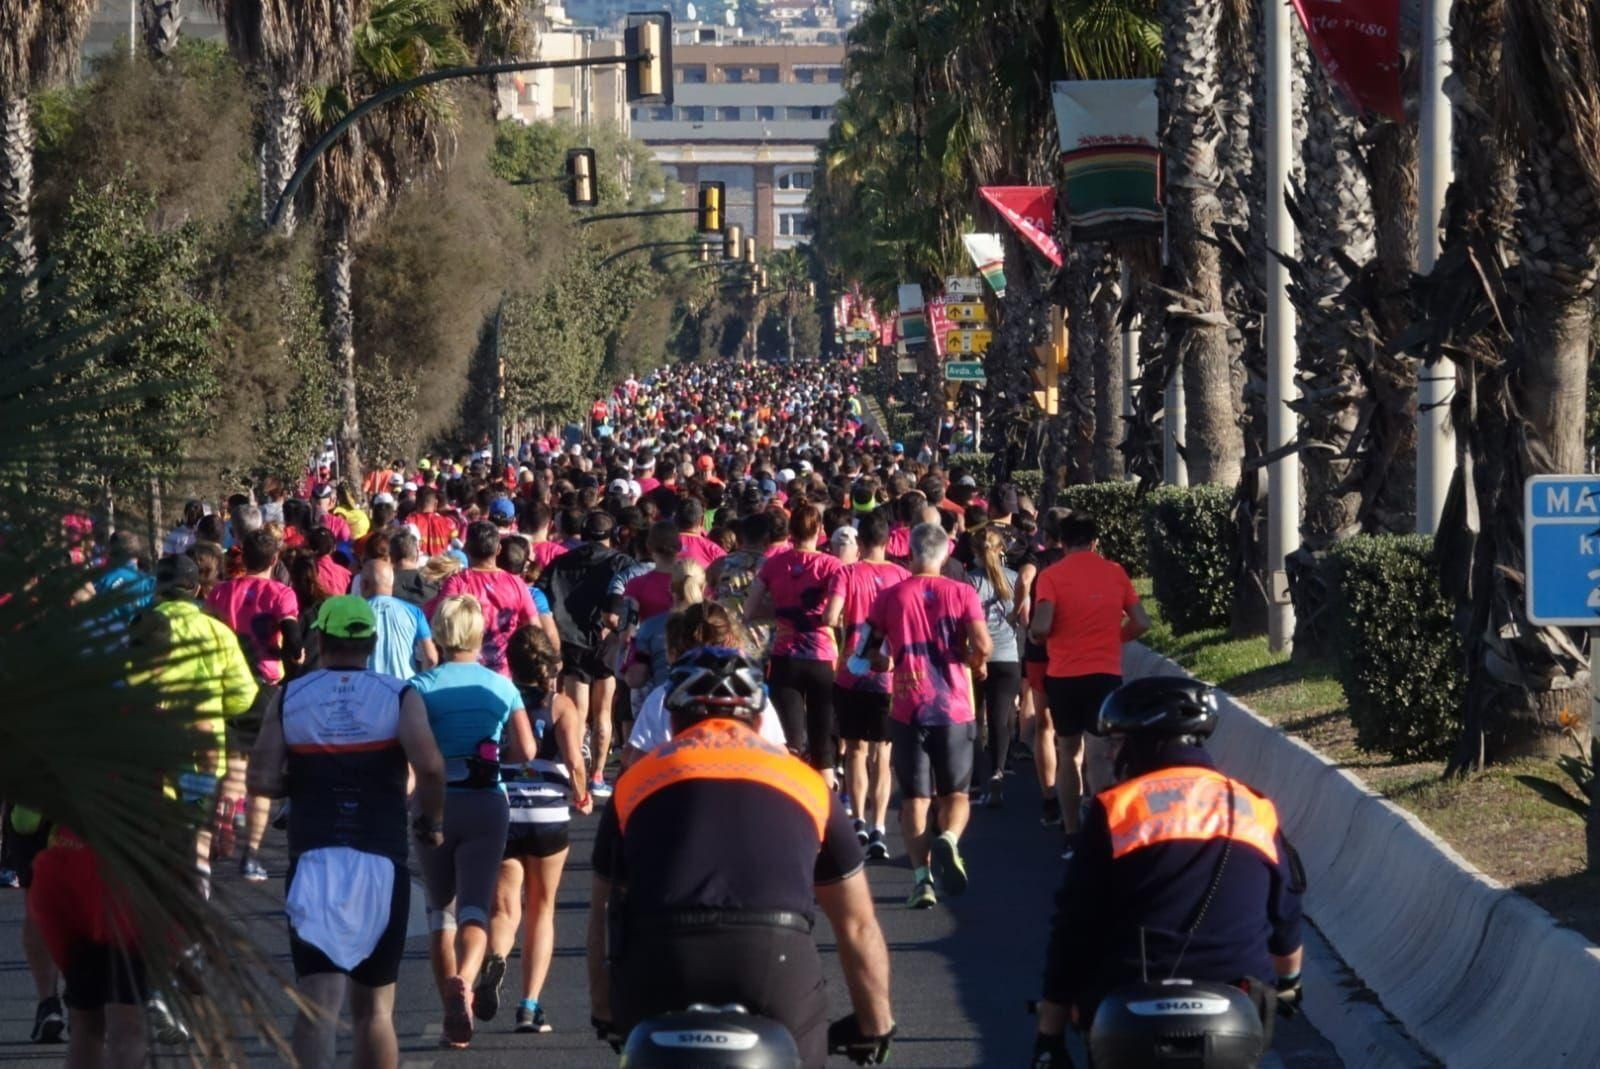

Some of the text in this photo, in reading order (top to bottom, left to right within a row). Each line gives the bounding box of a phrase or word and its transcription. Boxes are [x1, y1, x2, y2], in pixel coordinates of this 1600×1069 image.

[1345, 19, 1387, 37] ruso
[1547, 486, 1600, 513] MA
[1580, 534, 1600, 555] k
[1156, 1001, 1203, 1010] SHAD
[677, 1034, 729, 1044] SHAD
